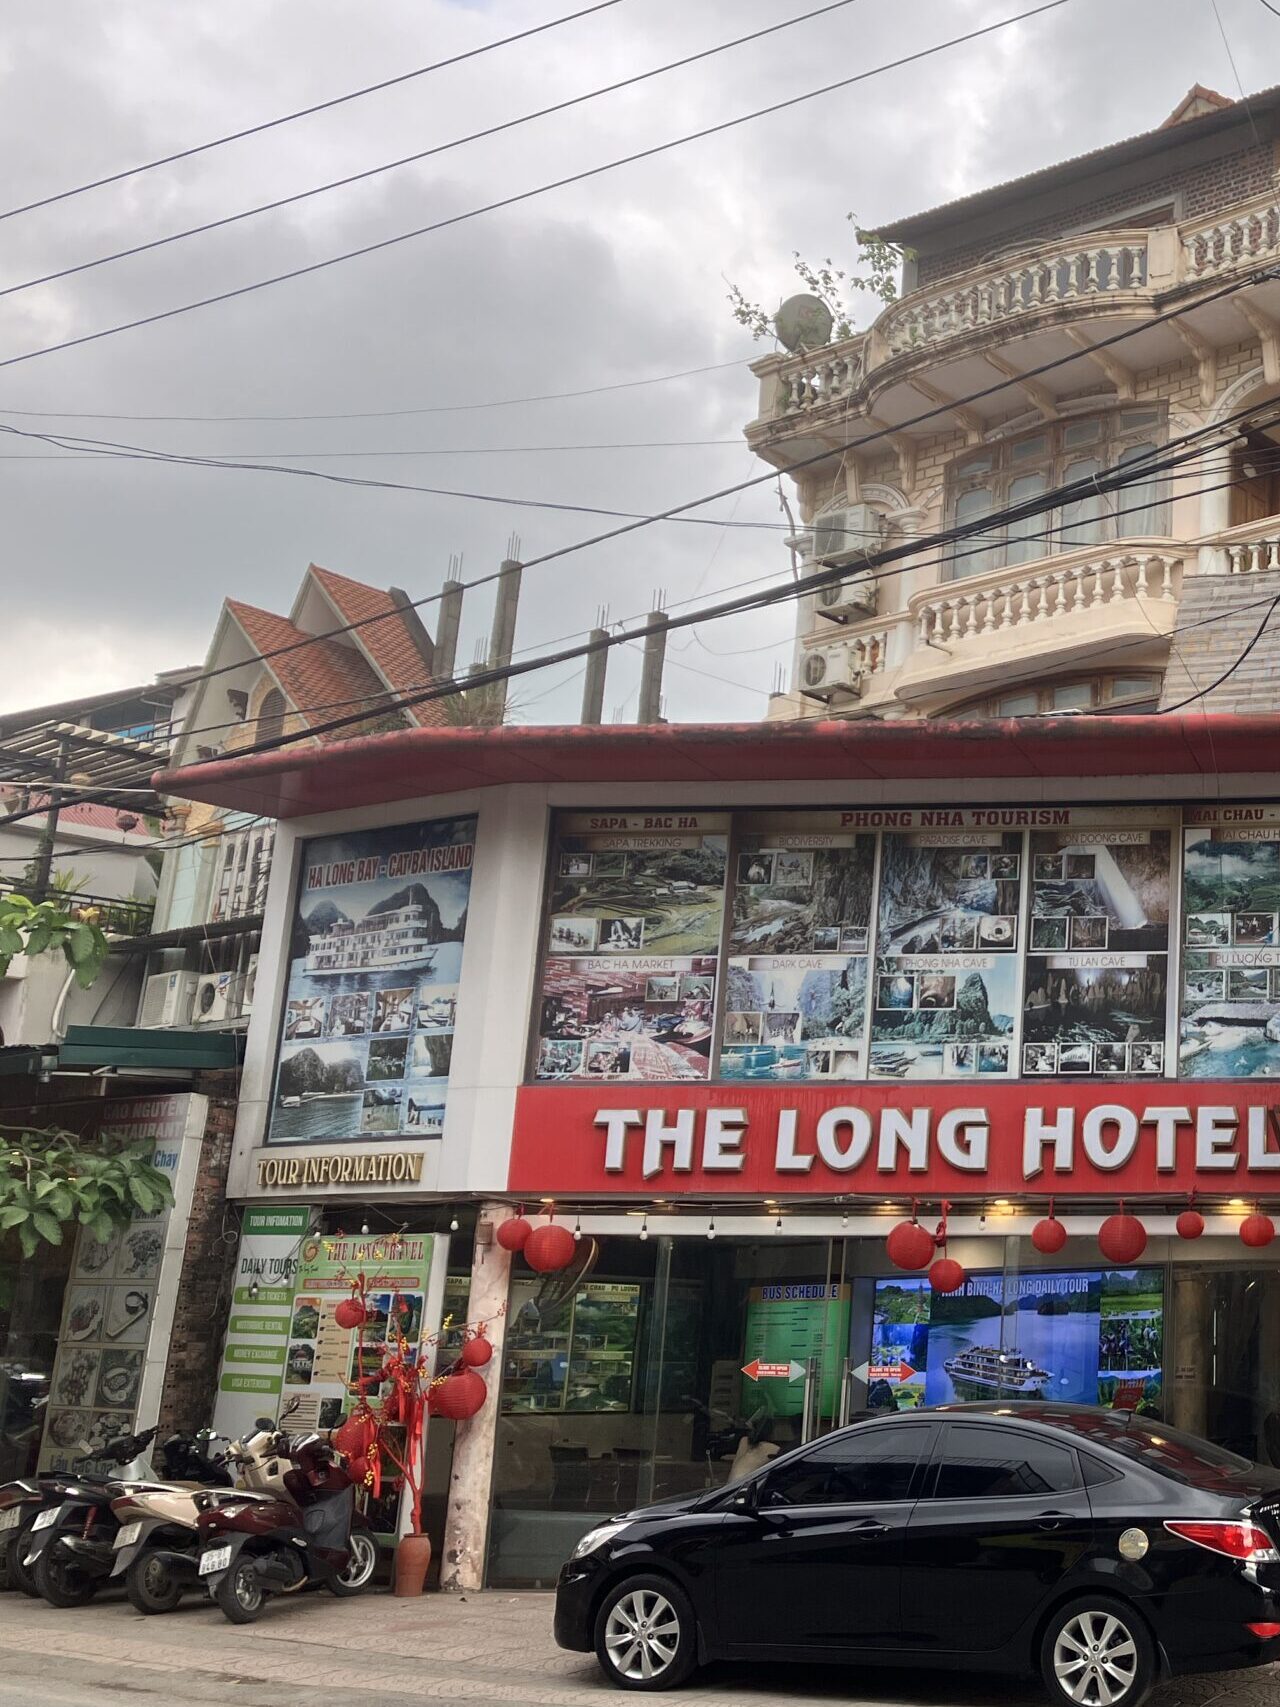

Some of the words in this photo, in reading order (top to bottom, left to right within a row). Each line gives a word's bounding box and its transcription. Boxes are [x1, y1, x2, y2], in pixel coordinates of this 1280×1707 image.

[841, 812, 912, 827] PHONG
[920, 811, 965, 826] NHA
[972, 810, 1070, 825] TOURISM
[1223, 808, 1264, 821] CHAU
[590, 817, 628, 829] SAPA
[643, 817, 673, 829] BAC
[678, 816, 698, 828] HA
[919, 834, 961, 845] PARADISE
[962, 833, 988, 845] CAVE
[1119, 831, 1144, 843] CAVE
[1239, 829, 1270, 840] CHAU
[602, 838, 629, 849] SAPA
[632, 837, 682, 849] TREKKING
[778, 835, 834, 847] BIODIVERSITY
[307, 864, 324, 890] HA
[324, 859, 355, 887] LONG
[356, 856, 381, 882] BAY
[387, 852, 411, 879] CAT
[410, 849, 430, 876] BA
[429, 843, 474, 873] ISLAND
[587, 959, 611, 970] BAC
[613, 959, 630, 970] HA
[633, 958, 675, 970] MARKET
[772, 959, 796, 969] DARK
[798, 959, 824, 969] CAVE
[905, 957, 937, 969] PHONG
[940, 957, 960, 969] NHA
[962, 957, 988, 968] CAVE
[1081, 956, 1098, 967] LAN
[1100, 956, 1126, 967] CAVE
[593, 1107, 748, 1180] THE
[774, 1104, 992, 1174] LONG
[257, 1158, 300, 1186] TOUR
[302, 1152, 422, 1184] INFORMATION
[250, 1215, 266, 1227] TOUR
[241, 1257, 267, 1275] DAILY
[269, 1257, 299, 1275] TOURS
[1007, 1279, 1033, 1295] LONG
[1035, 1278, 1062, 1295] DAILY
[1063, 1278, 1089, 1294] TOUR
[762, 1286, 782, 1300] BUS
